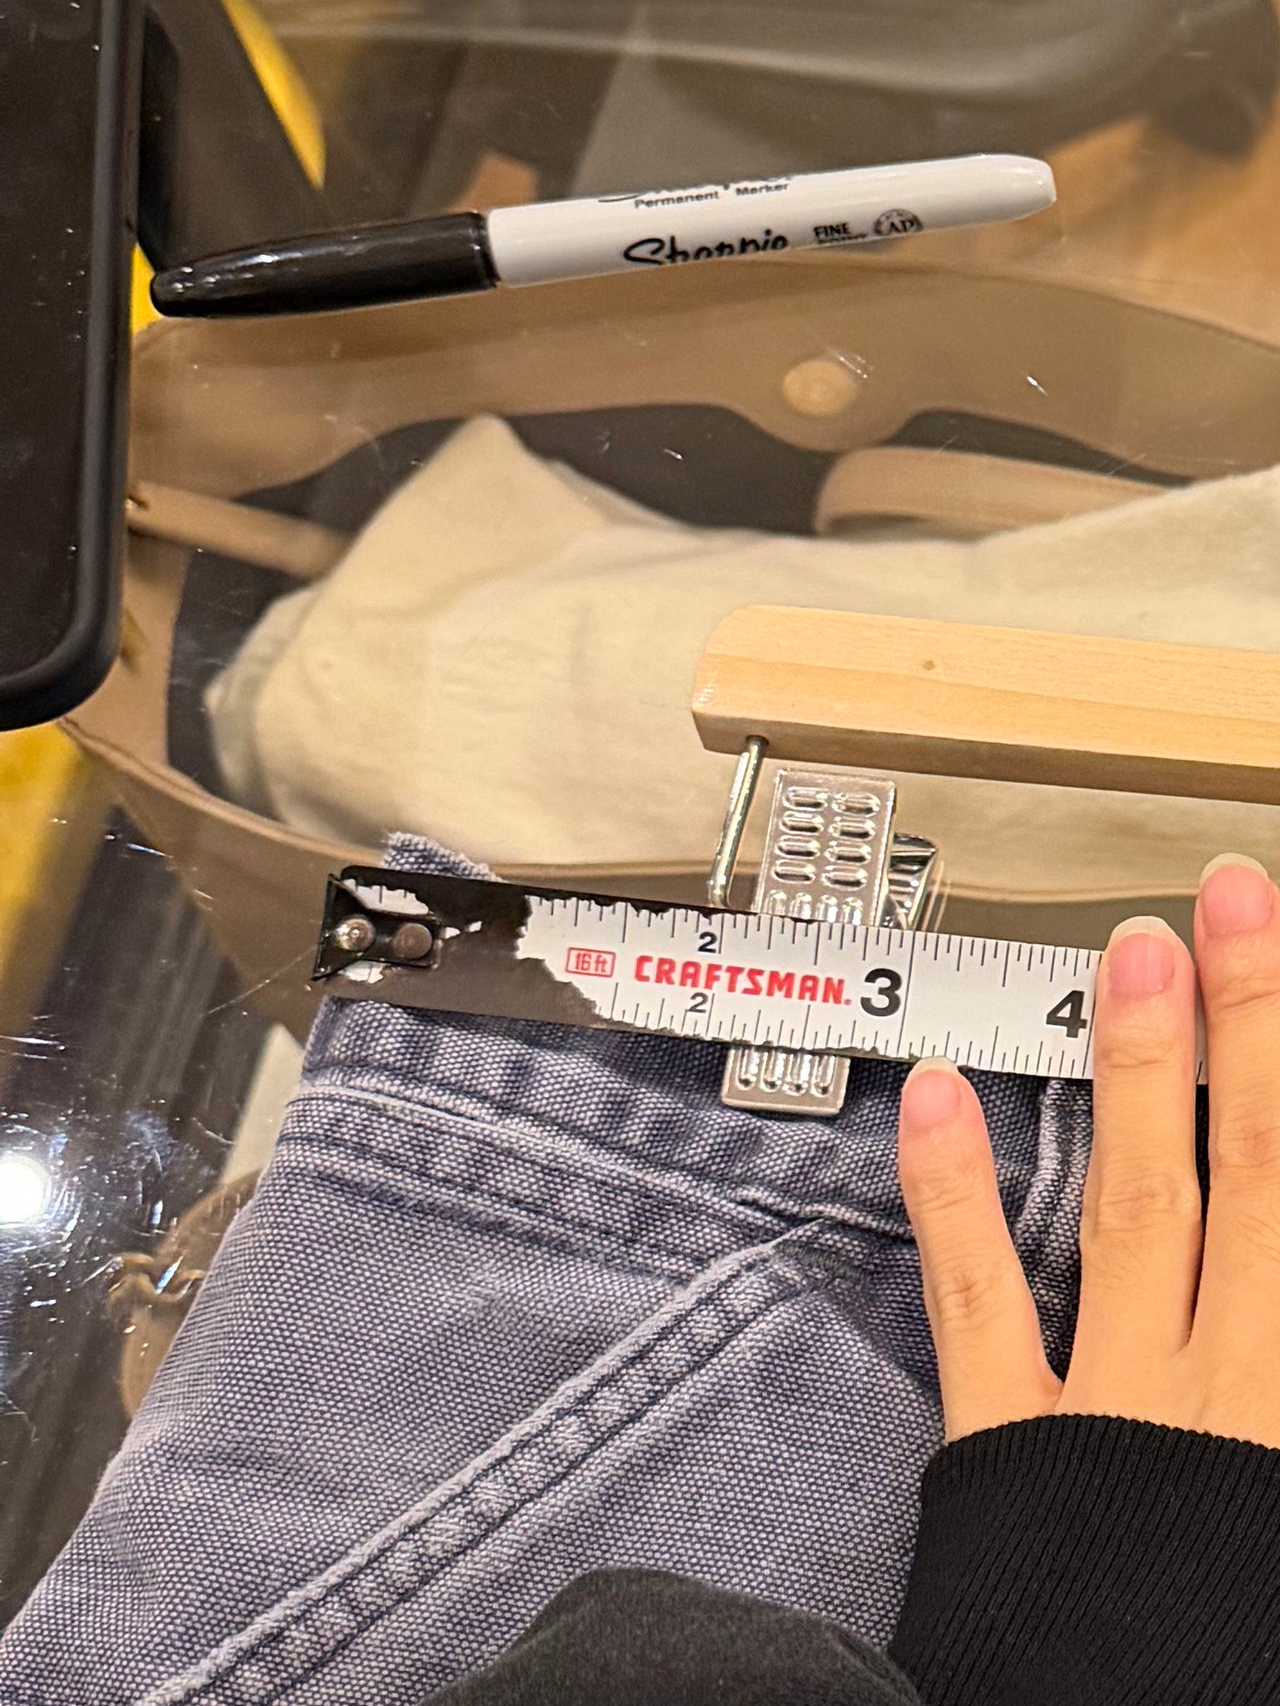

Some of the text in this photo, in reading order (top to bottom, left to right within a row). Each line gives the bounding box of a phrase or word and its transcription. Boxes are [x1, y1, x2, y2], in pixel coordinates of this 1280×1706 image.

[633, 190, 720, 209] Permanent
[735, 183, 789, 197] Marker
[813, 222, 850, 239] FINE
[698, 932, 718, 953] 2
[634, 955, 846, 1005] CRAFTSMAN
[860, 967, 904, 1019] 3
[689, 992, 708, 1014] 2
[1045, 989, 1088, 1039] 4
